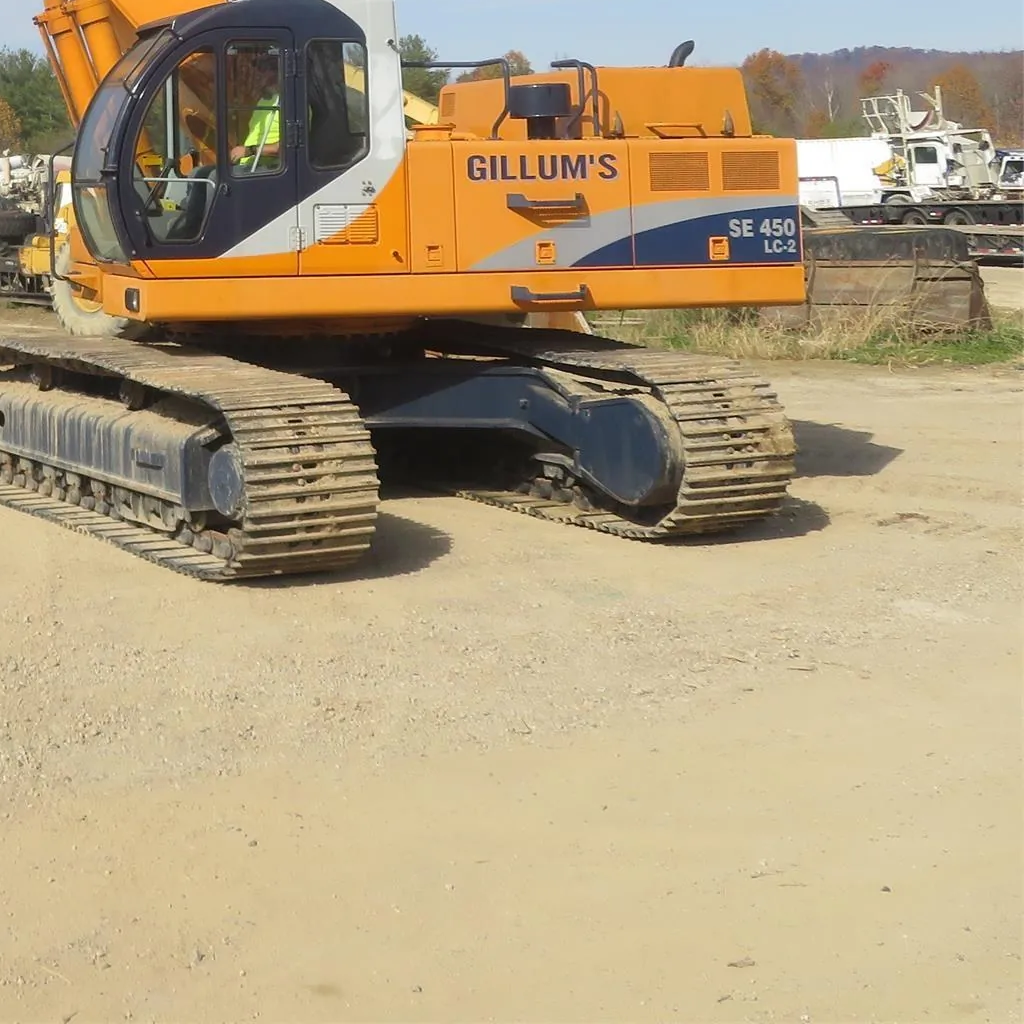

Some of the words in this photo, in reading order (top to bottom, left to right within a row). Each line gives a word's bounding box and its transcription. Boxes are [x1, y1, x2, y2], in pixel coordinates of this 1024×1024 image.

[467, 153, 618, 180] GILLUM'S
[729, 218, 754, 237] SE
[759, 218, 796, 237] 450
[764, 239, 797, 253] LC-2
